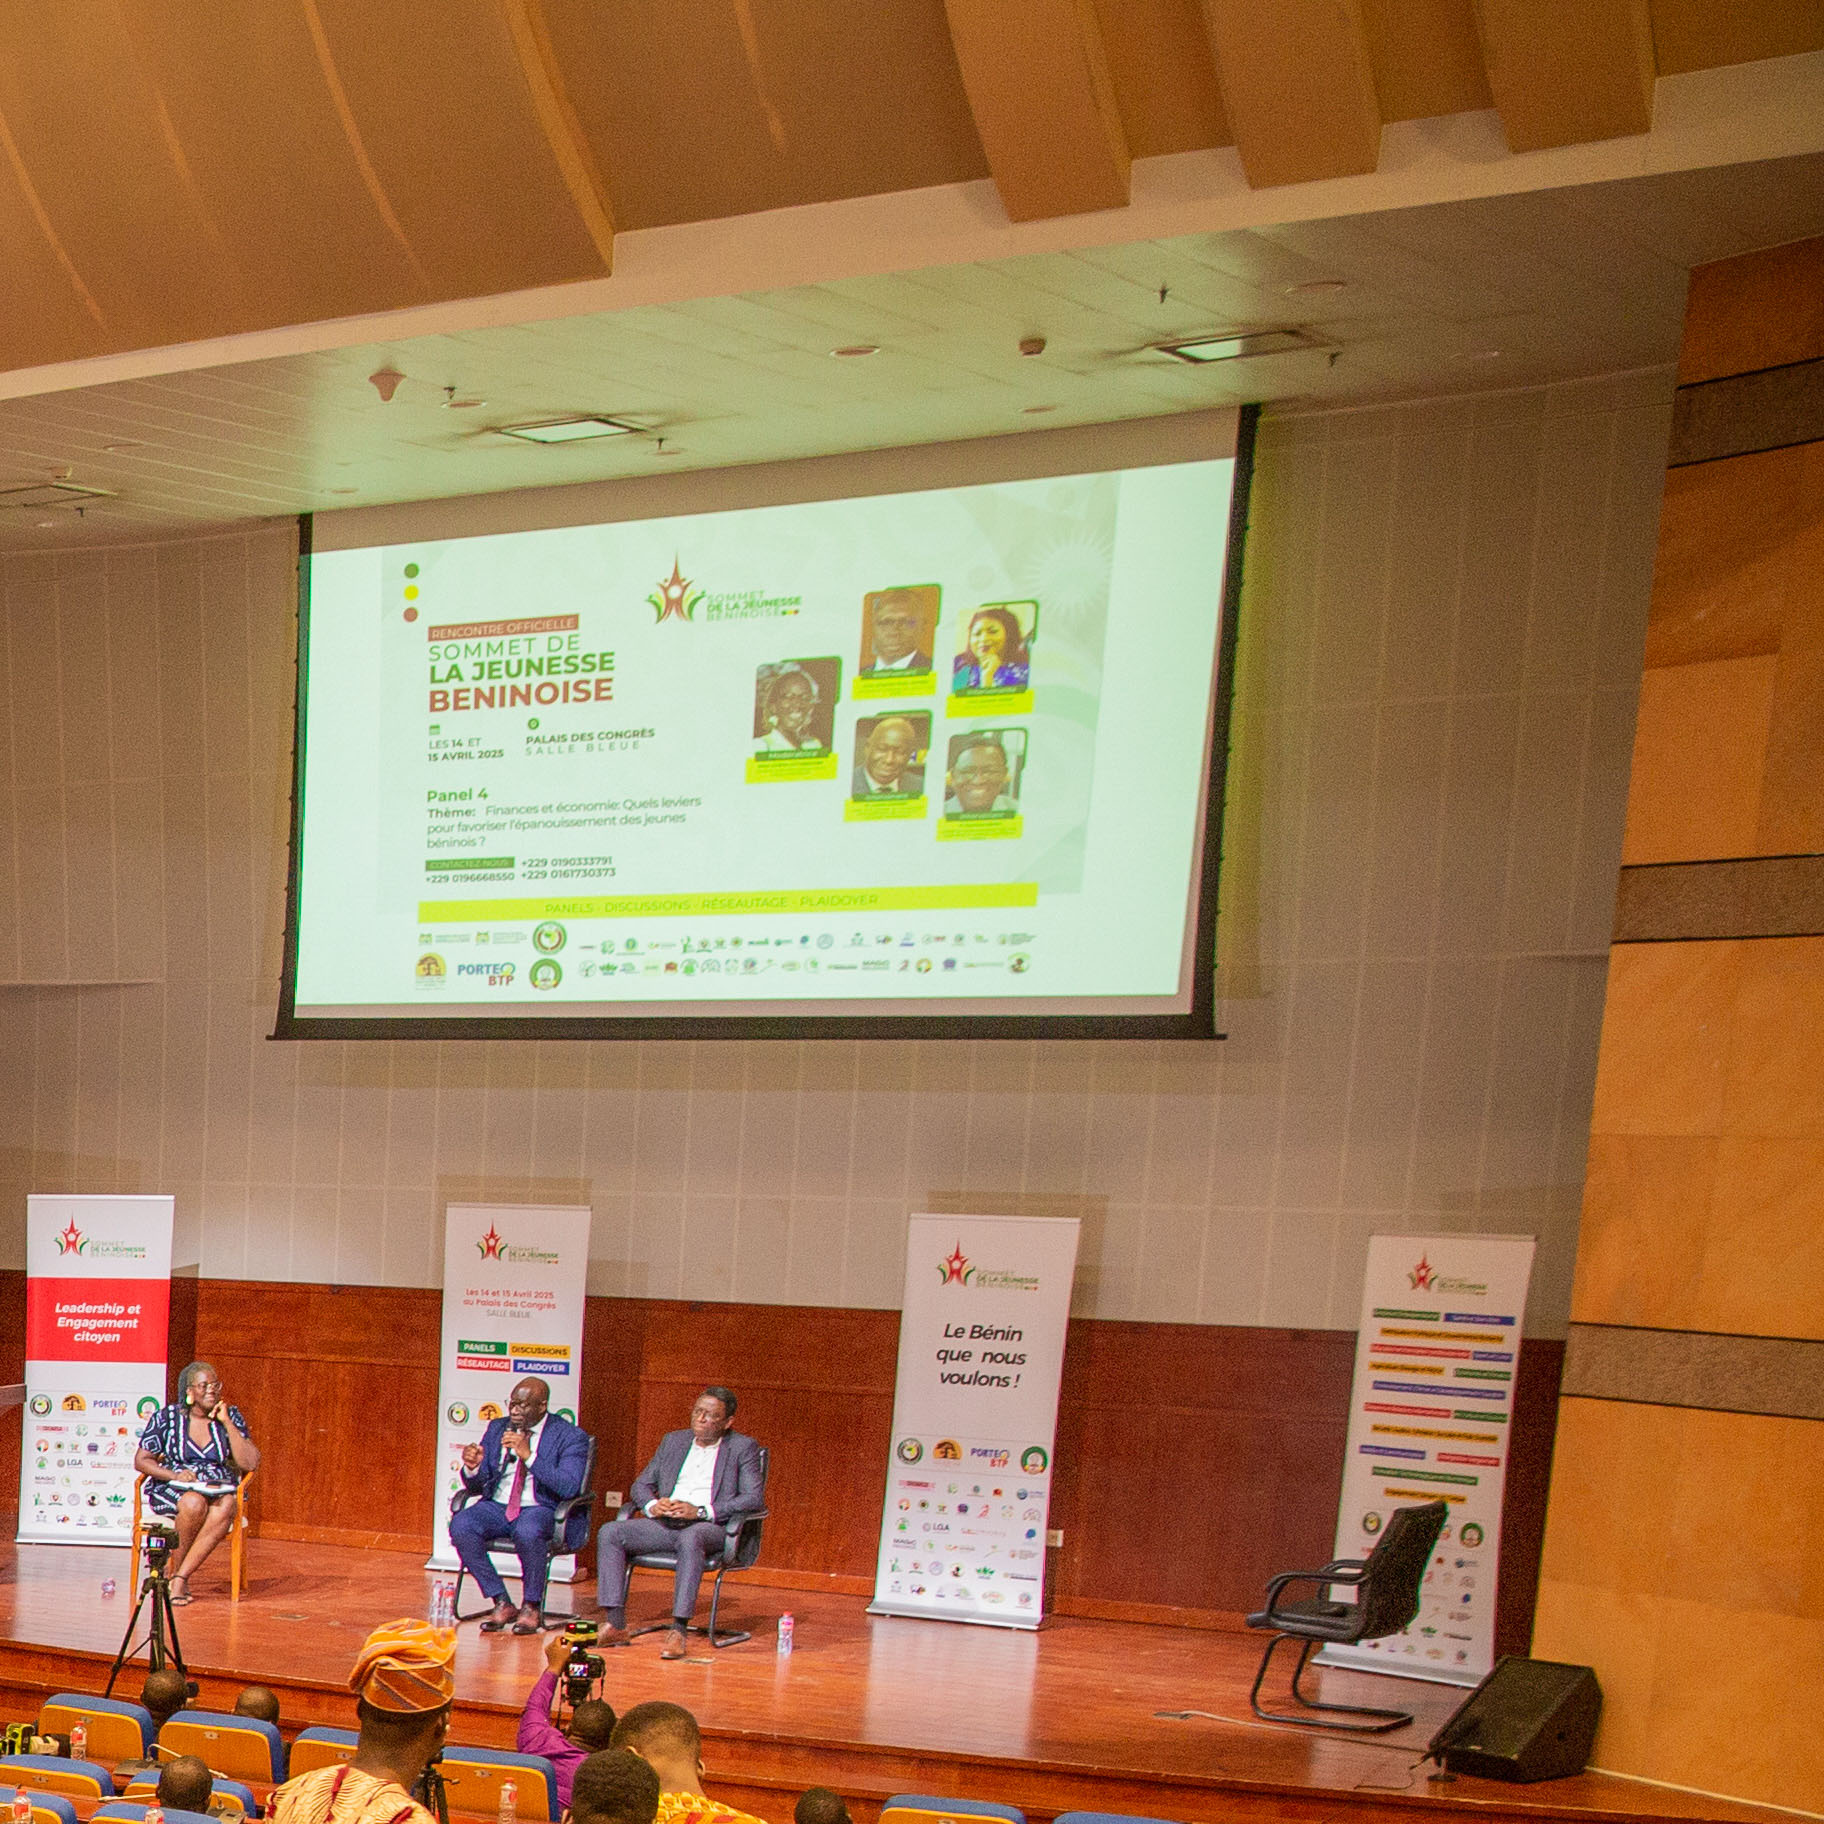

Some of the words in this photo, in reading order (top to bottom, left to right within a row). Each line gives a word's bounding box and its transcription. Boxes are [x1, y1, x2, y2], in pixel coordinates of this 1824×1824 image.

[707, 603, 722, 613] DE
[725, 601, 740, 610] LA
[743, 596, 801, 609] JEUNESSE
[432, 623, 503, 639] RENCONTRE
[506, 618, 575, 633] OFFICIELLE
[429, 637, 536, 662] SOMMET
[547, 634, 580, 652] DE
[429, 664, 464, 684] LA
[472, 651, 615, 681] JEUNESSE
[429, 677, 614, 713] BENINOISE
[525, 733, 568, 745] PALAIS
[570, 732, 595, 743] DES
[596, 727, 656, 741] CONGRÈS
[429, 740, 449, 750] LES
[451, 739, 463, 748] 14
[468, 737, 482, 747] ET
[525, 743, 576, 756] SALLE
[586, 740, 641, 752] BLEUE
[428, 752, 439, 762] 15
[441, 750, 475, 761] AVRIL
[478, 749, 504, 759] 2025
[427, 787, 472, 803] Panel
[477, 787, 489, 800] 4
[427, 807, 476, 819] Thème:
[485, 804, 539, 817] Finances
[540, 803, 553, 814] et
[555, 800, 621, 813] économie:
[622, 798, 659, 811] Quels
[661, 795, 702, 808] leviers
[427, 822, 455, 835] pour
[457, 819, 507, 833] favoriser
[619, 813, 642, 826] des
[643, 812, 686, 827] jeunes
[427, 835, 477, 849] béninois
[521, 858, 547, 868] +229
[425, 874, 449, 883] +229
[521, 869, 547, 880] +229
[545, 902, 593, 914] PANELS
[604, 900, 691, 913] DISCUSSIONS
[799, 894, 879, 908] PLAIDOYER
[488, 975, 514, 986] BTP
[534, 1291, 554, 1299] 2025
[55, 1302, 125, 1315] Leadership
[127, 1304, 141, 1315] et
[476, 1299, 501, 1307] Palais
[503, 1300, 518, 1308] des
[57, 1317, 138, 1330] Engagement
[74, 1332, 120, 1344] citoyen
[943, 1323, 965, 1339] Le
[969, 1323, 1022, 1342] Bénin
[464, 1342, 496, 1352] PANELS
[512, 1345, 568, 1356] DISCUSSIONS
[936, 1349, 972, 1365] que
[981, 1351, 1027, 1365] nous
[517, 1362, 566, 1372] PLAIDOYER
